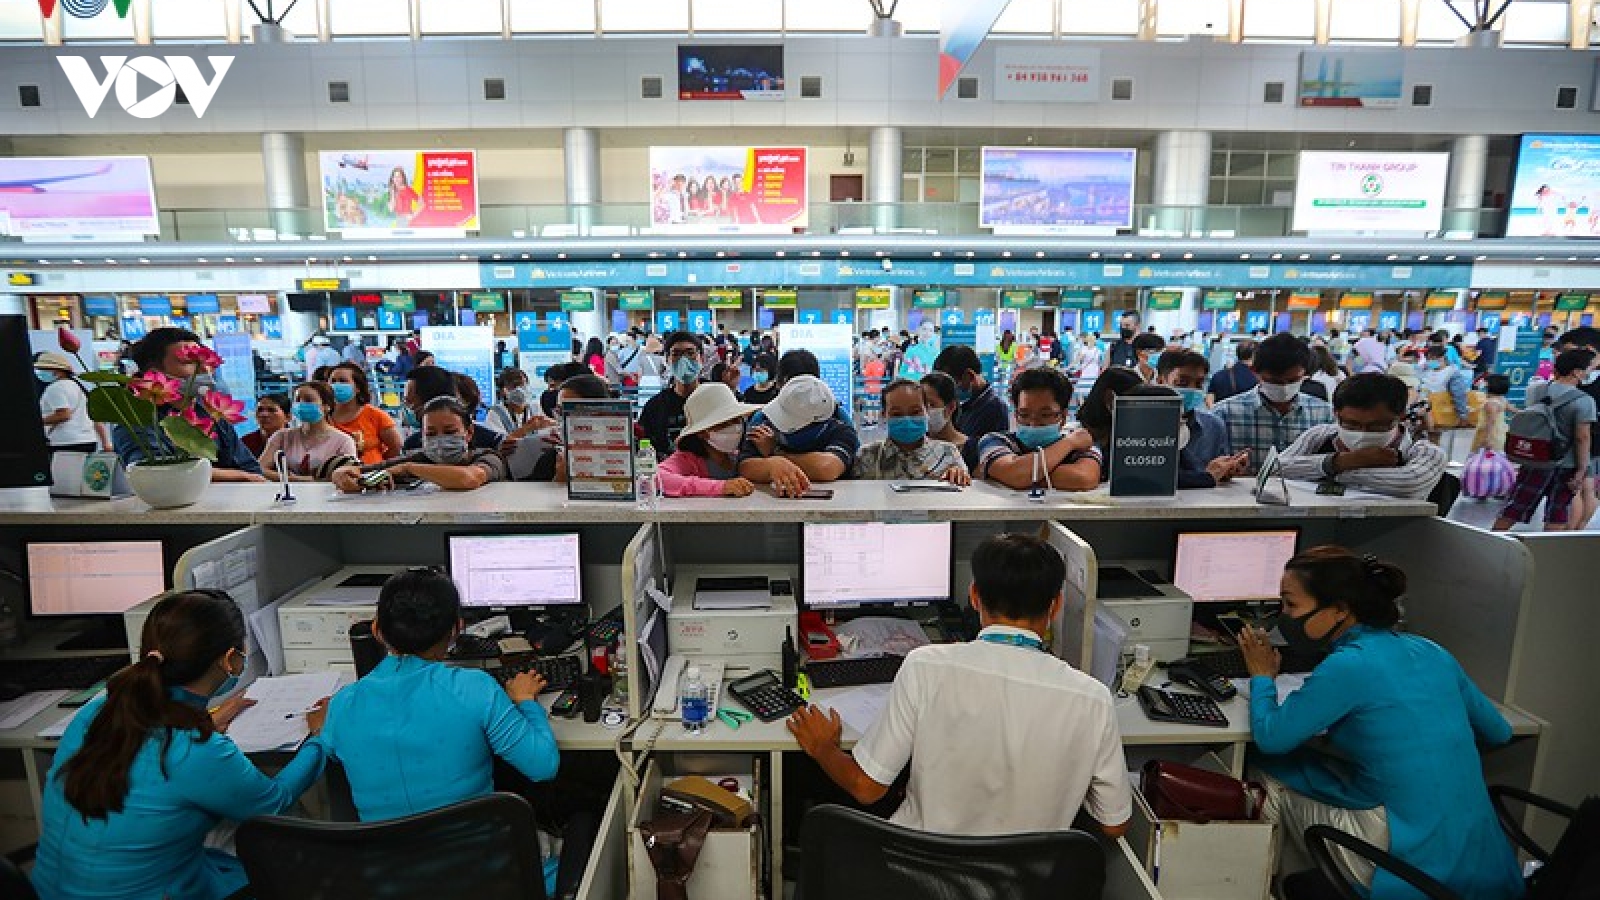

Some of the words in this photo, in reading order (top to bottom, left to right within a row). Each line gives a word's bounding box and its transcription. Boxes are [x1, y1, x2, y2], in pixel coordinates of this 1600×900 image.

[1332, 162, 1346, 171] TIN
[1349, 162, 1380, 171] THANH
[1383, 163, 1419, 172] GROUP
[341, 311, 348, 324] 1
[386, 312, 394, 324] 2
[522, 316, 530, 330] 3
[554, 316, 563, 330] 4
[664, 315, 672, 328] 5
[696, 315, 704, 329] 6
[806, 314, 815, 324] 7
[948, 314, 957, 325] 9
[1086, 315, 1098, 328] 11
[1124, 455, 1166, 465] CLOSED
